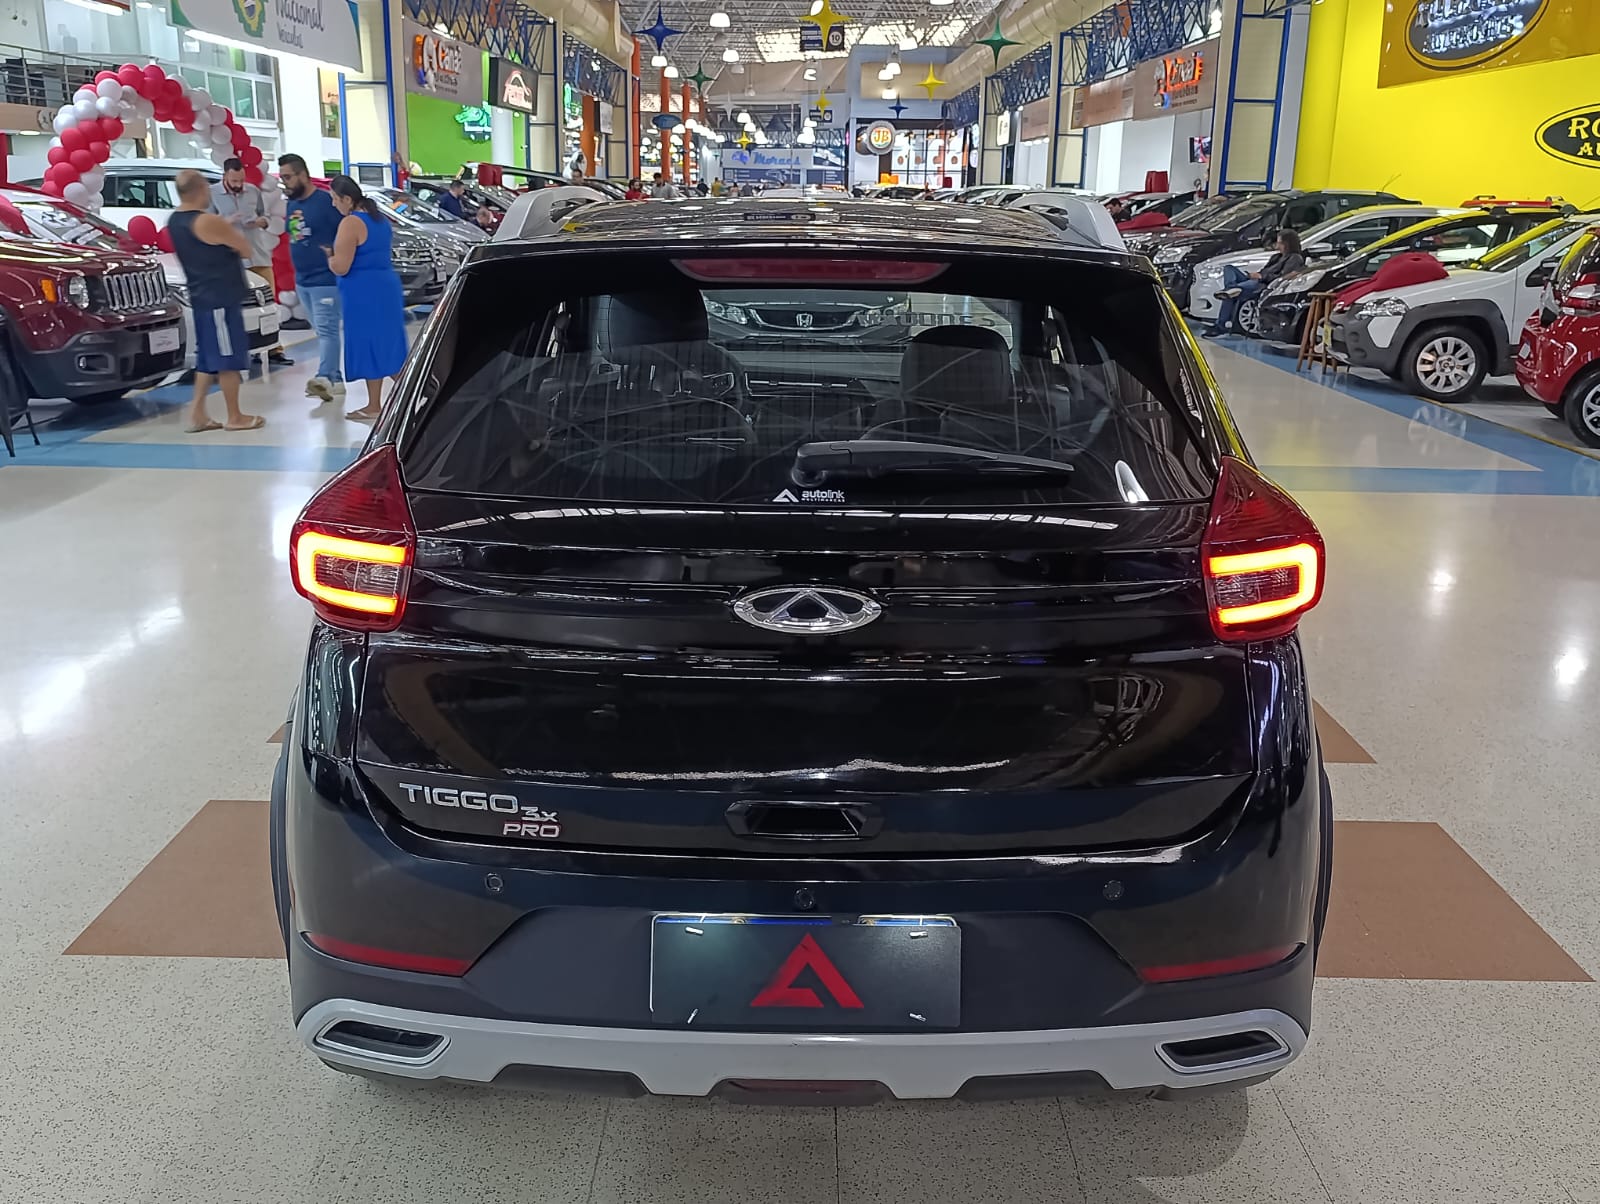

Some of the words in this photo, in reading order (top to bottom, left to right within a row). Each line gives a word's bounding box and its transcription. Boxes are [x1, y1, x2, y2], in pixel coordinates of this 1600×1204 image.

[276, 0, 324, 32] Nacional
[831, 34, 841, 42] 10
[1577, 142, 1600, 156] A
[753, 151, 801, 166] Moraes
[801, 489, 845, 499] autolink
[399, 782, 519, 814] TIGGO
[503, 823, 560, 838] PRO
